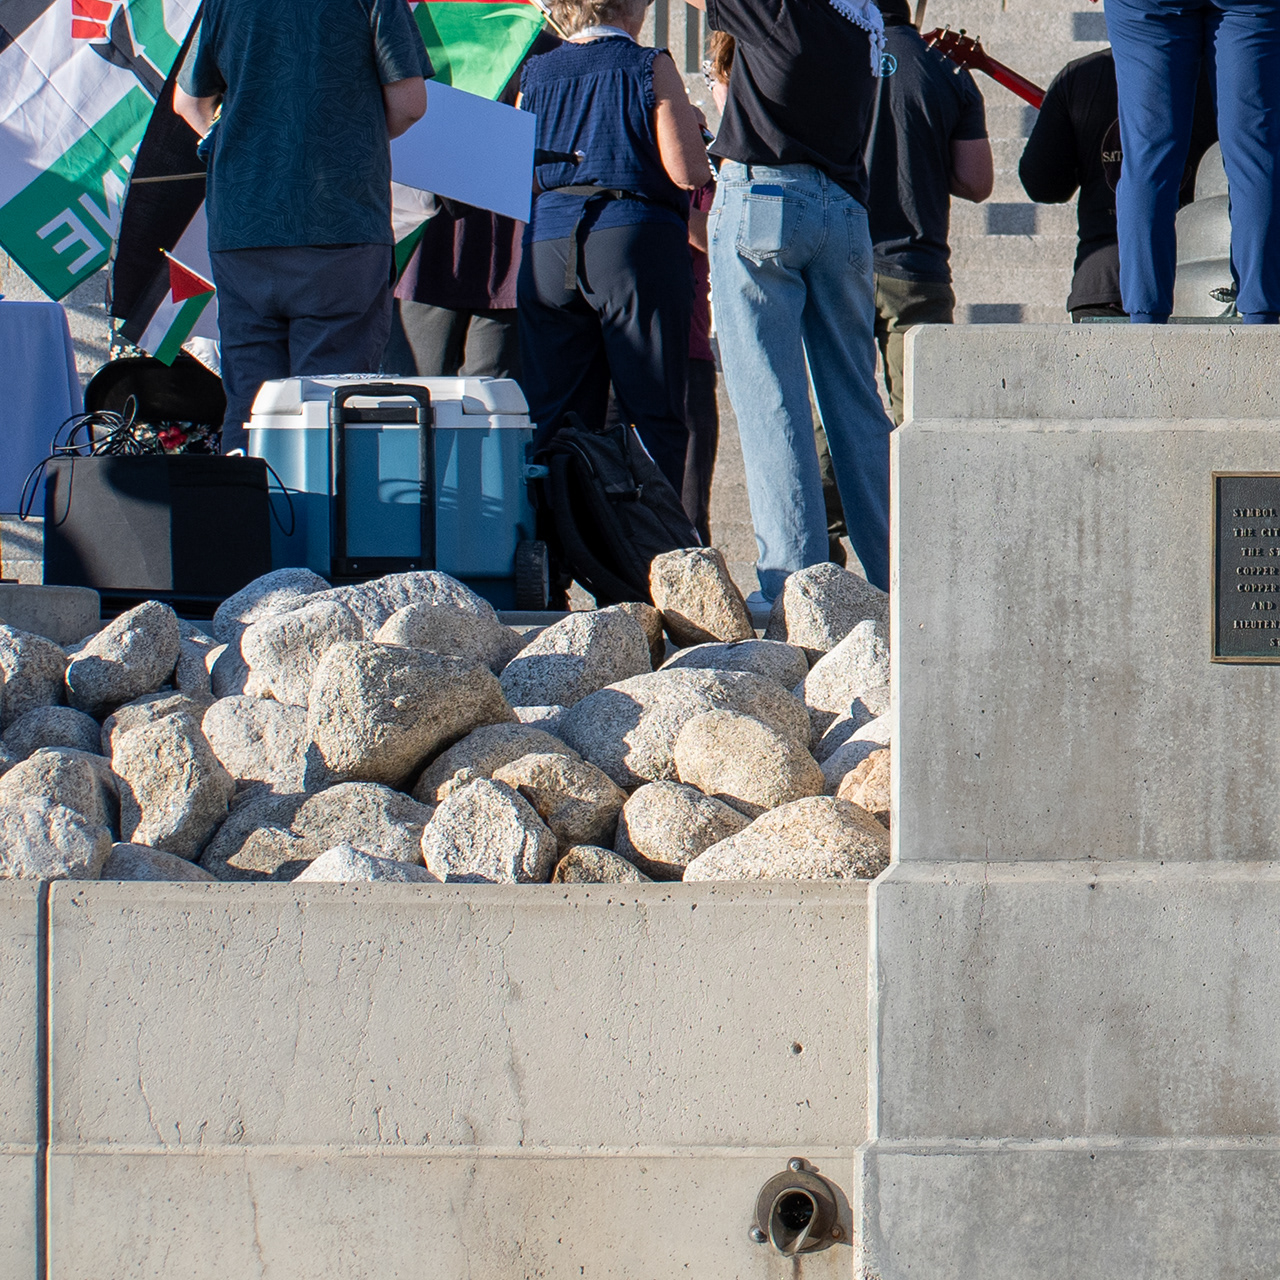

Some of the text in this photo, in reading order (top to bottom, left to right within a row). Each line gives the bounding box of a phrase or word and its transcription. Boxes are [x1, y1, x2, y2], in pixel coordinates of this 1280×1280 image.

[1232, 508, 1277, 518] SYMBOL
[1233, 527, 1256, 537] THE
[1241, 547, 1264, 557] THE
[1236, 566, 1279, 576] COPPER
[1237, 583, 1280, 593] COPPER
[1250, 601, 1277, 611] AND
